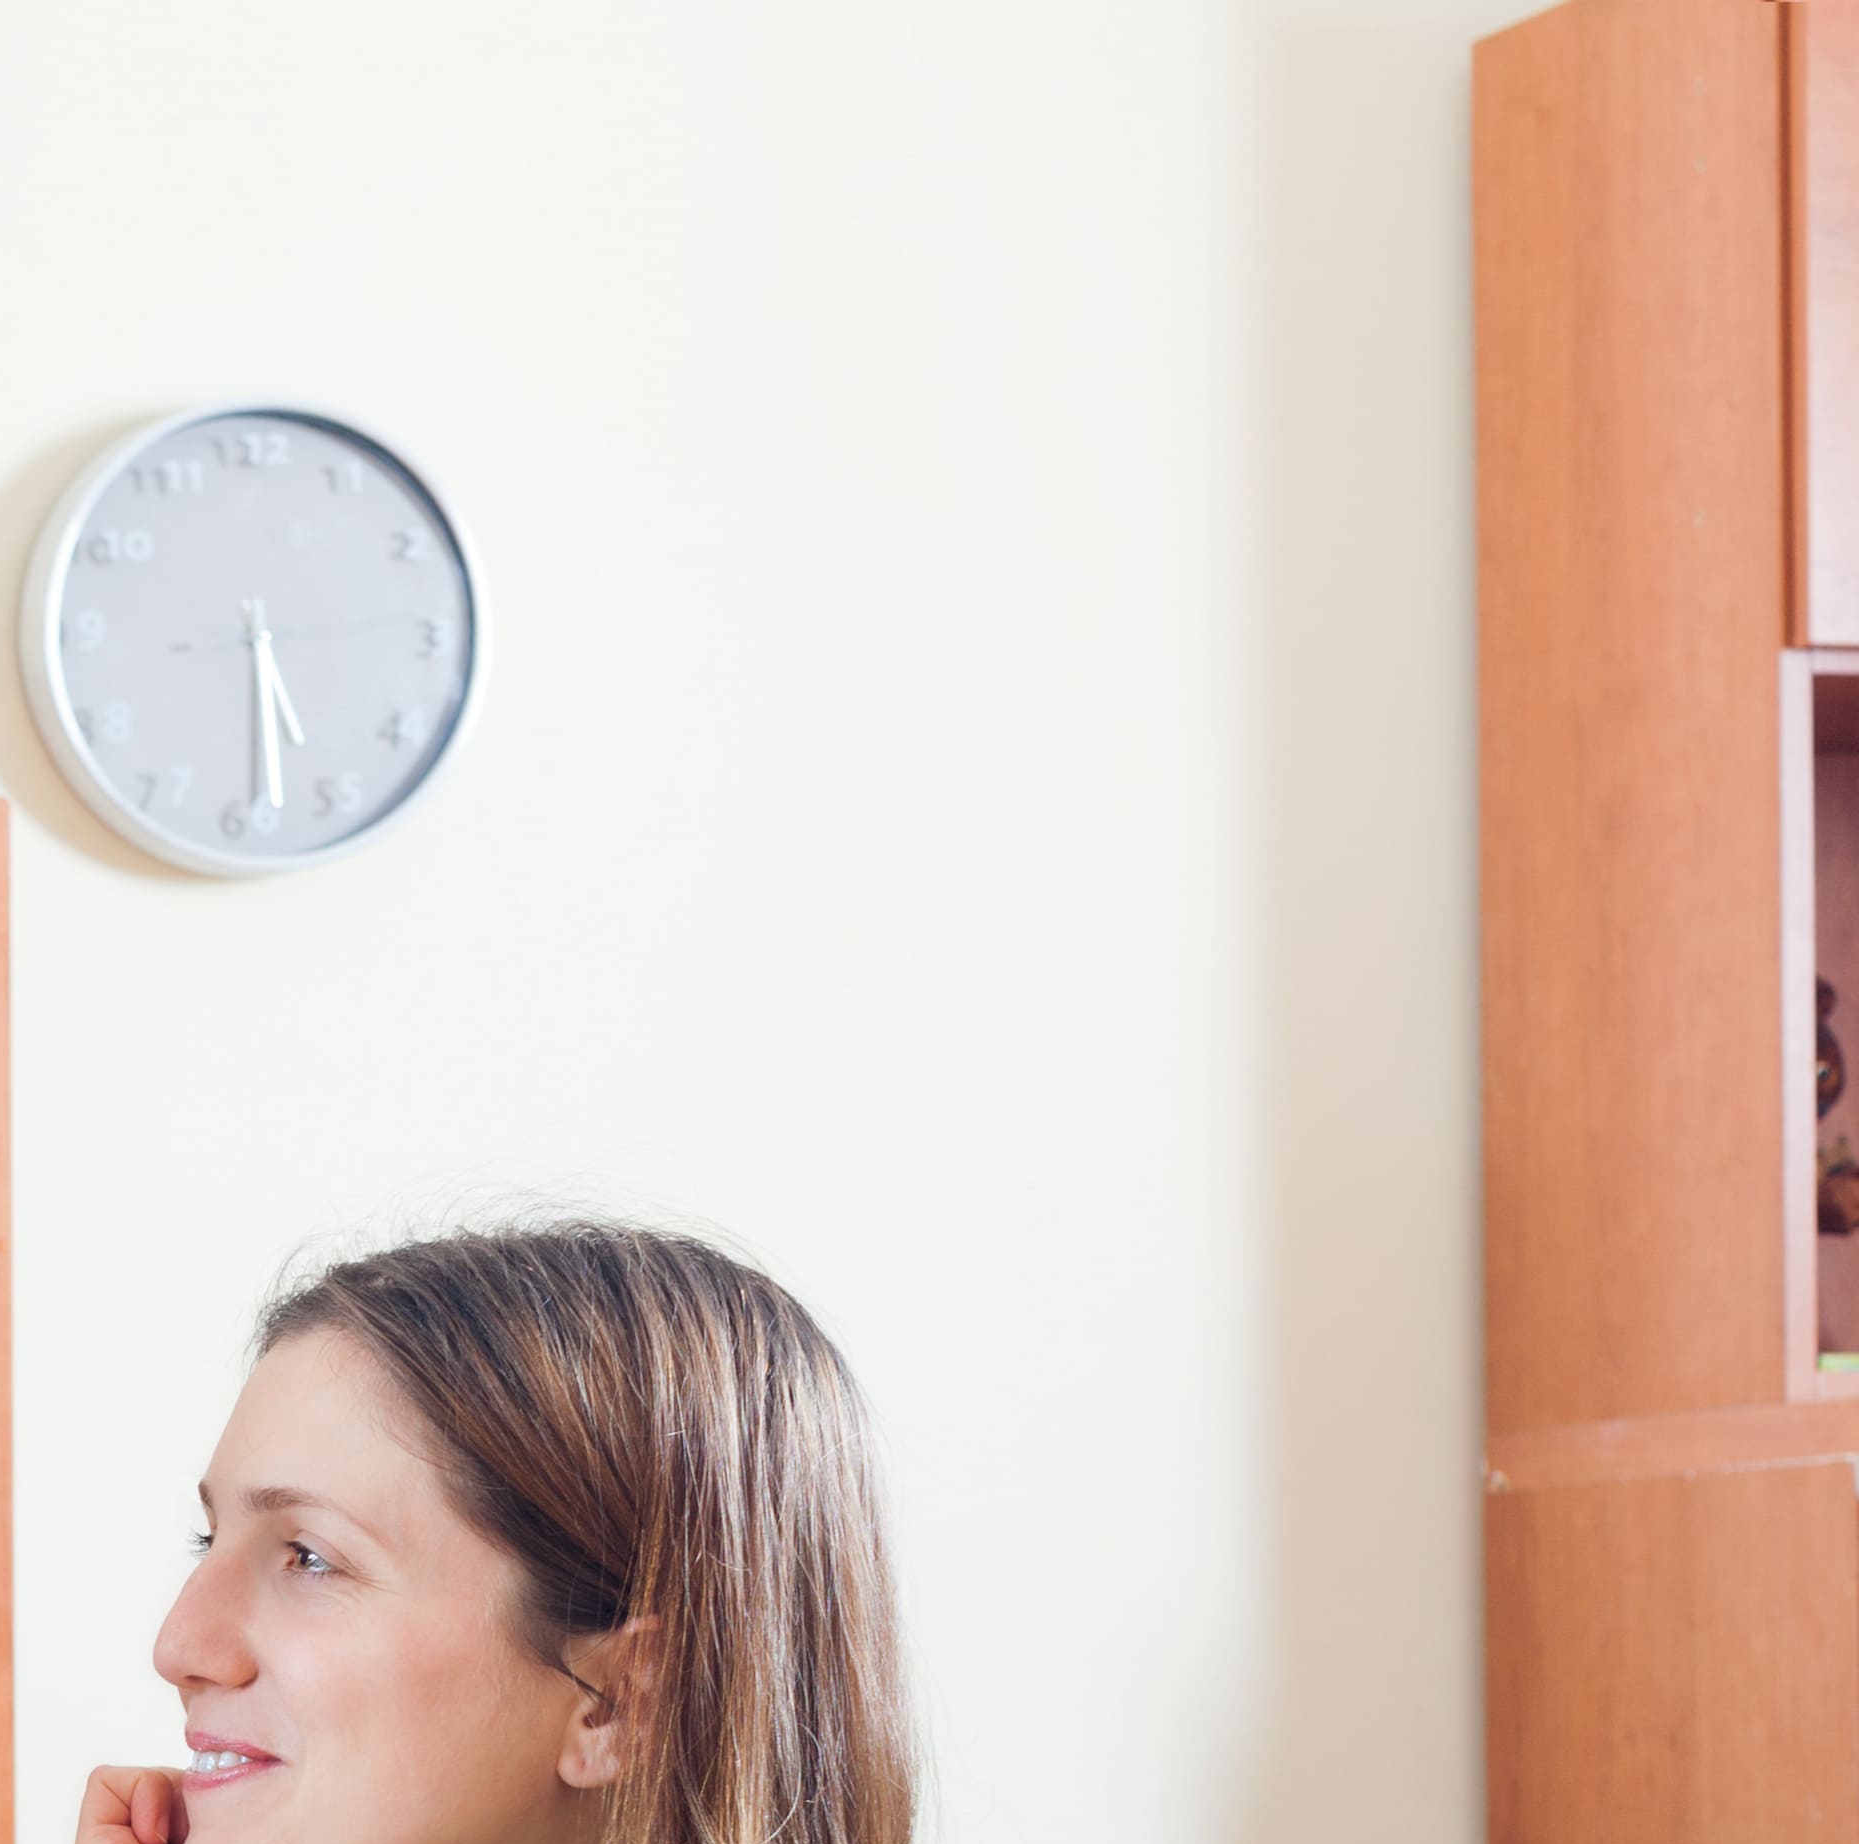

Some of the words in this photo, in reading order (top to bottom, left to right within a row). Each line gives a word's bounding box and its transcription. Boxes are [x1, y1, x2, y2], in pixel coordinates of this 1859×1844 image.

[244, 433, 290, 465] 12
[165, 462, 205, 492] 11
[103, 529, 153, 561] 10
[407, 528, 431, 560] 2
[77, 609, 105, 651] 9
[430, 616, 455, 657] 3
[103, 701, 132, 743] 8
[402, 708, 429, 744] 4
[167, 767, 195, 807] 7
[338, 772, 364, 811] 5
[252, 793, 280, 833] 6
